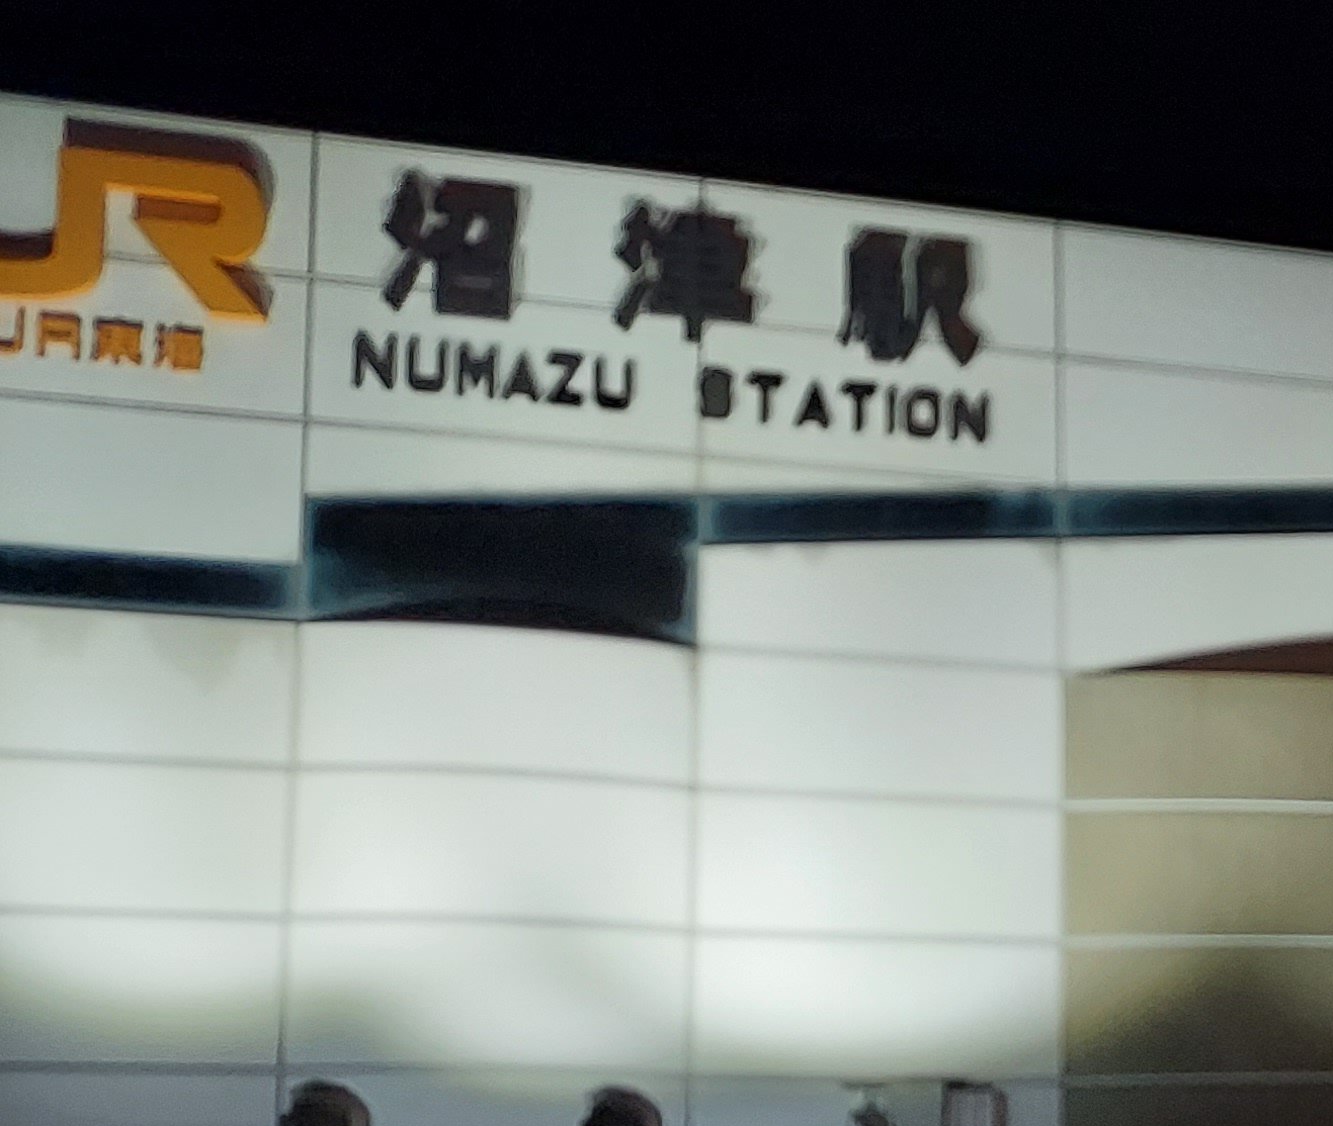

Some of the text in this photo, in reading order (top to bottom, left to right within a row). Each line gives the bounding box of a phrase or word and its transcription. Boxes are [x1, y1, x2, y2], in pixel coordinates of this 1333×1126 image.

[0, 117, 274, 320] JR
[383, 172, 980, 366] 沼津駅
[351, 330, 990, 442] NUMAZU STATION
